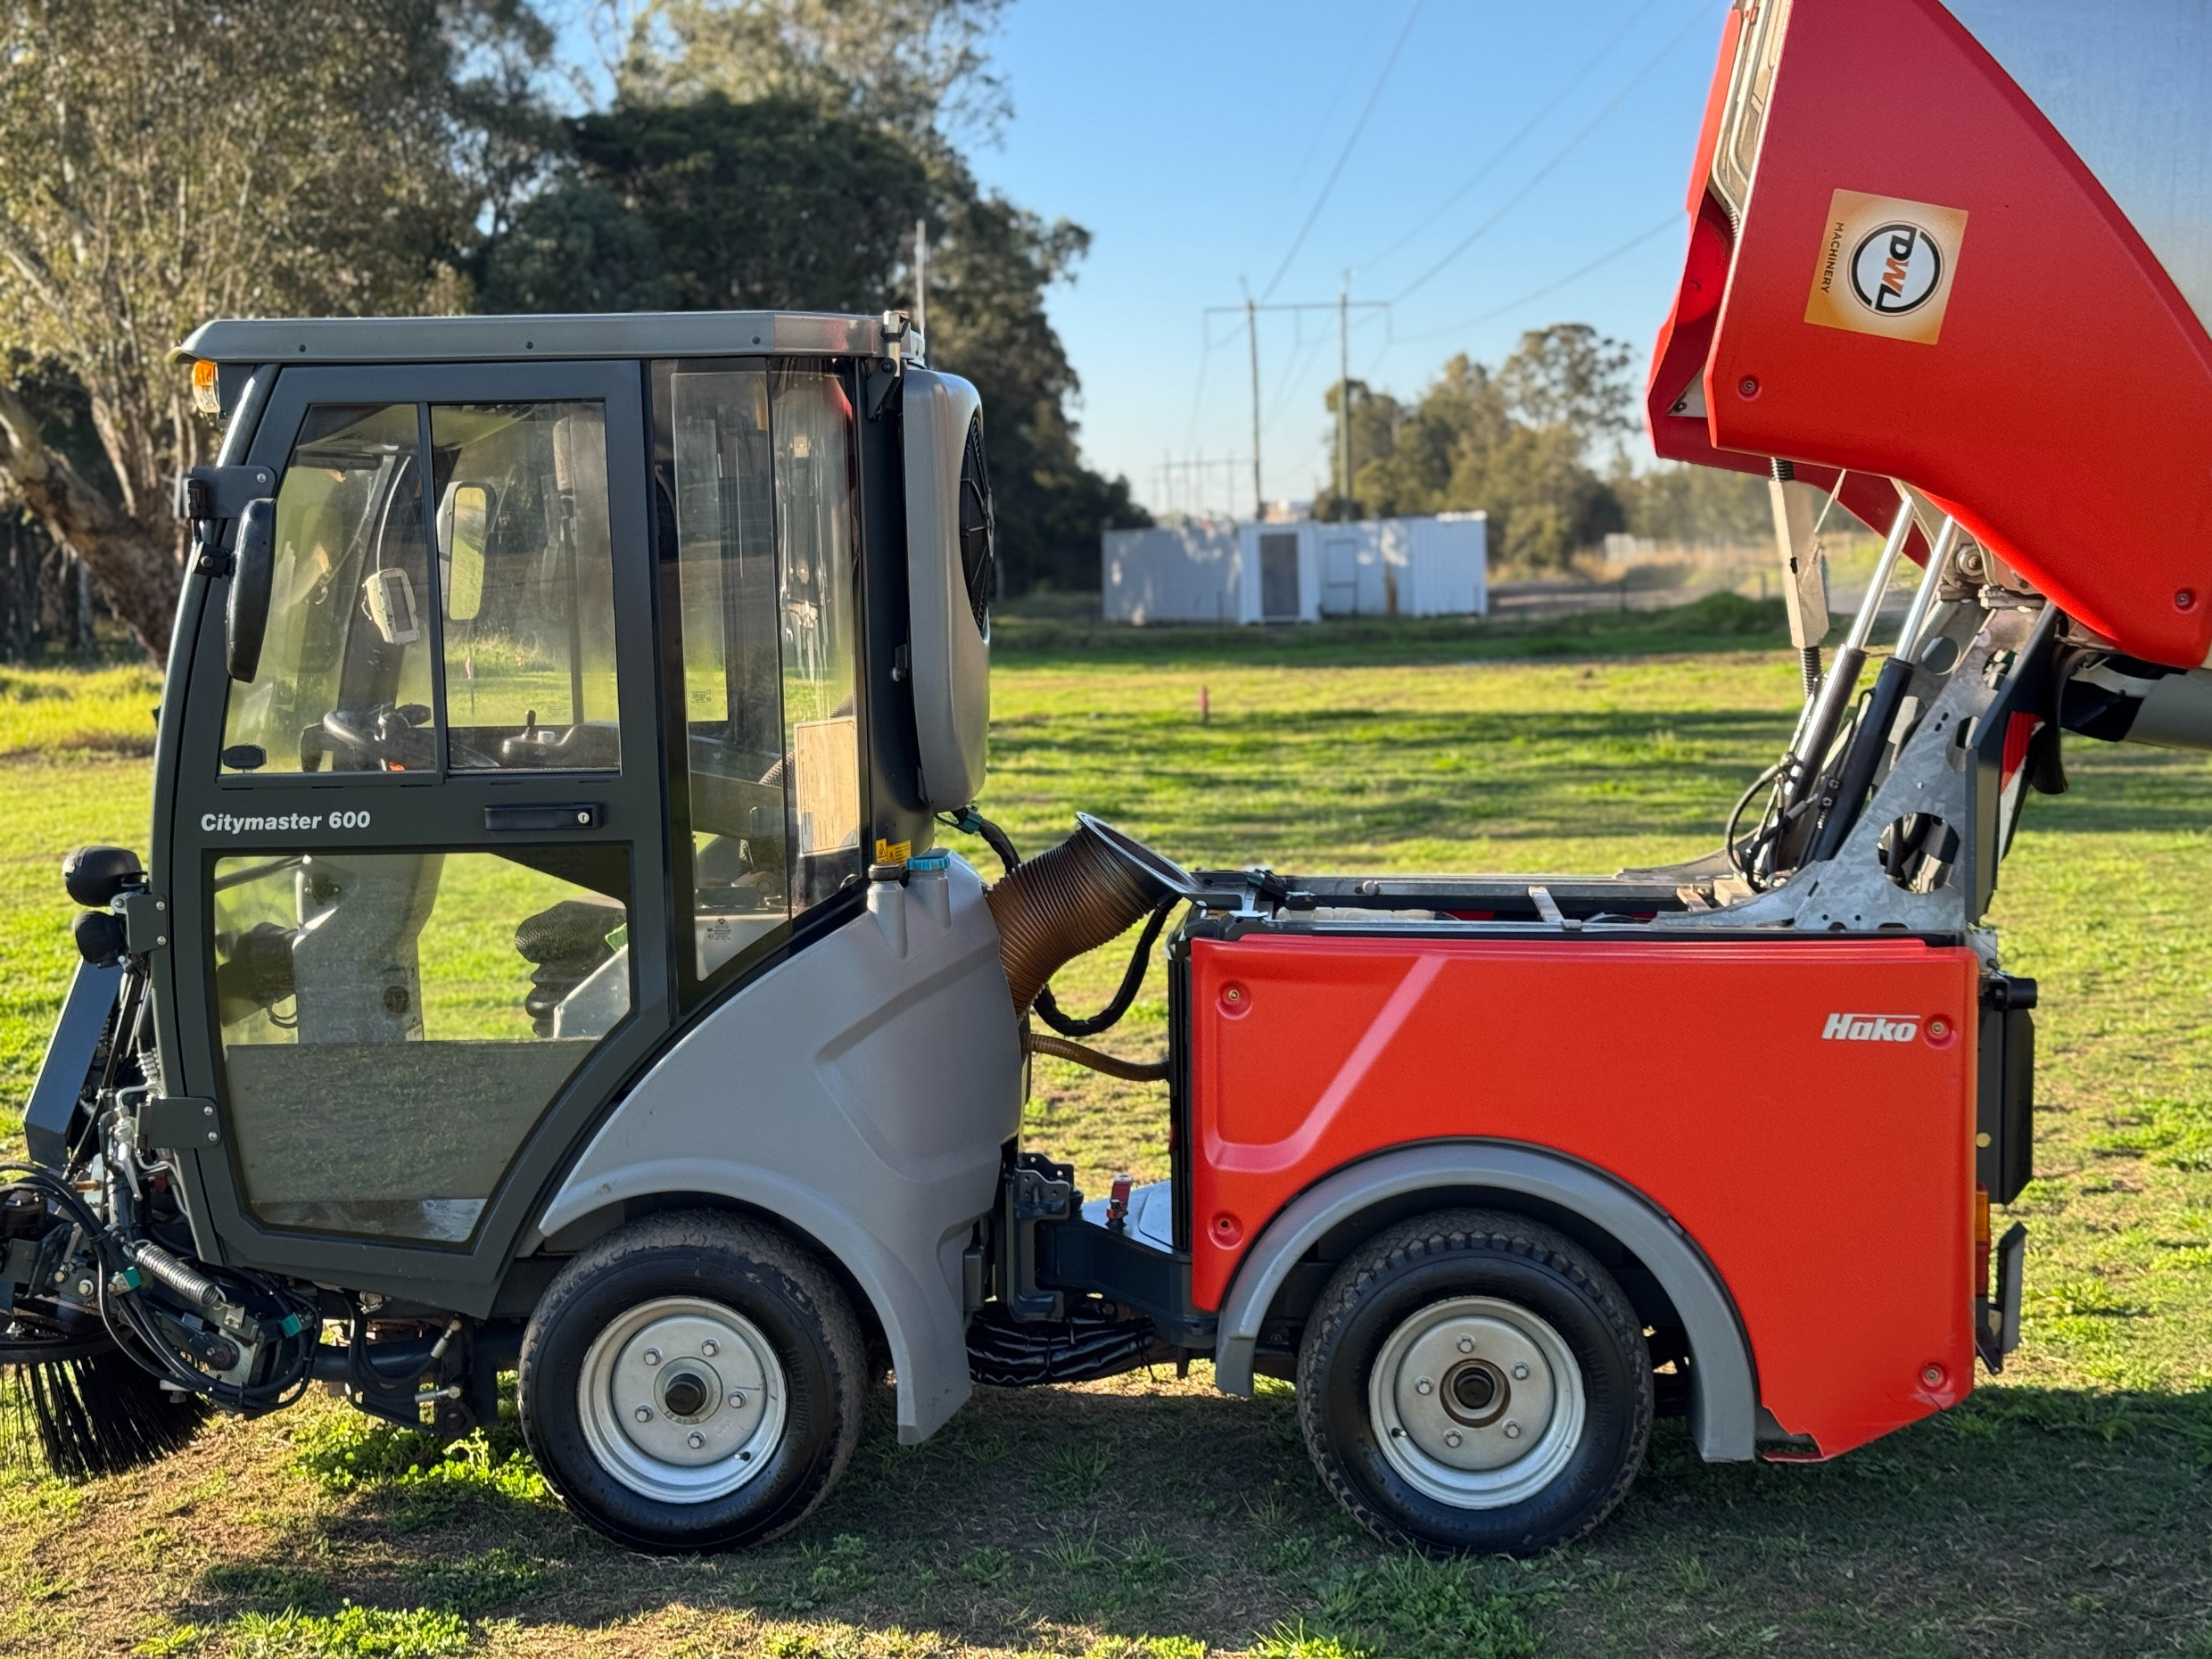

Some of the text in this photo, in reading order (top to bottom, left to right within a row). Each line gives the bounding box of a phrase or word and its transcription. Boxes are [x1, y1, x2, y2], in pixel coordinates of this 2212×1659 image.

[1820, 222, 1845, 294] MACHINERY
[1874, 226, 1918, 312] DWL
[201, 811, 371, 835] Citymaster 600
[1820, 1012, 1921, 1043] Hako
